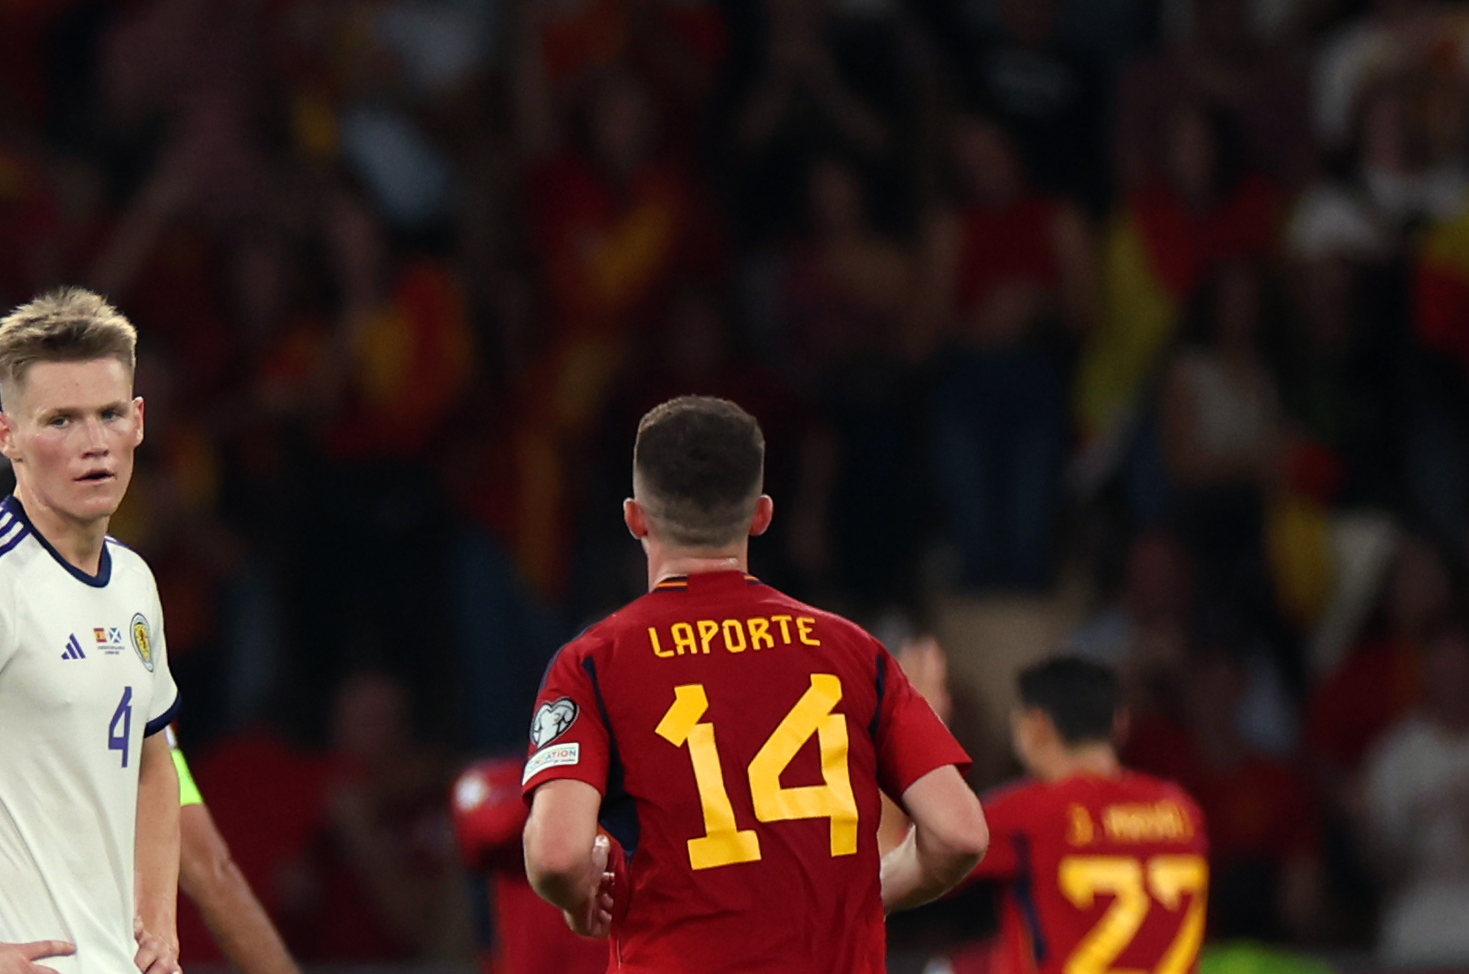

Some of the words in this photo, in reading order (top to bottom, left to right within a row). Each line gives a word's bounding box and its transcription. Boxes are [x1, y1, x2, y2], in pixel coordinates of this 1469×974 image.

[647, 615, 821, 658] LAPORTE
[108, 686, 133, 769] 4
[654, 673, 859, 870] 14
